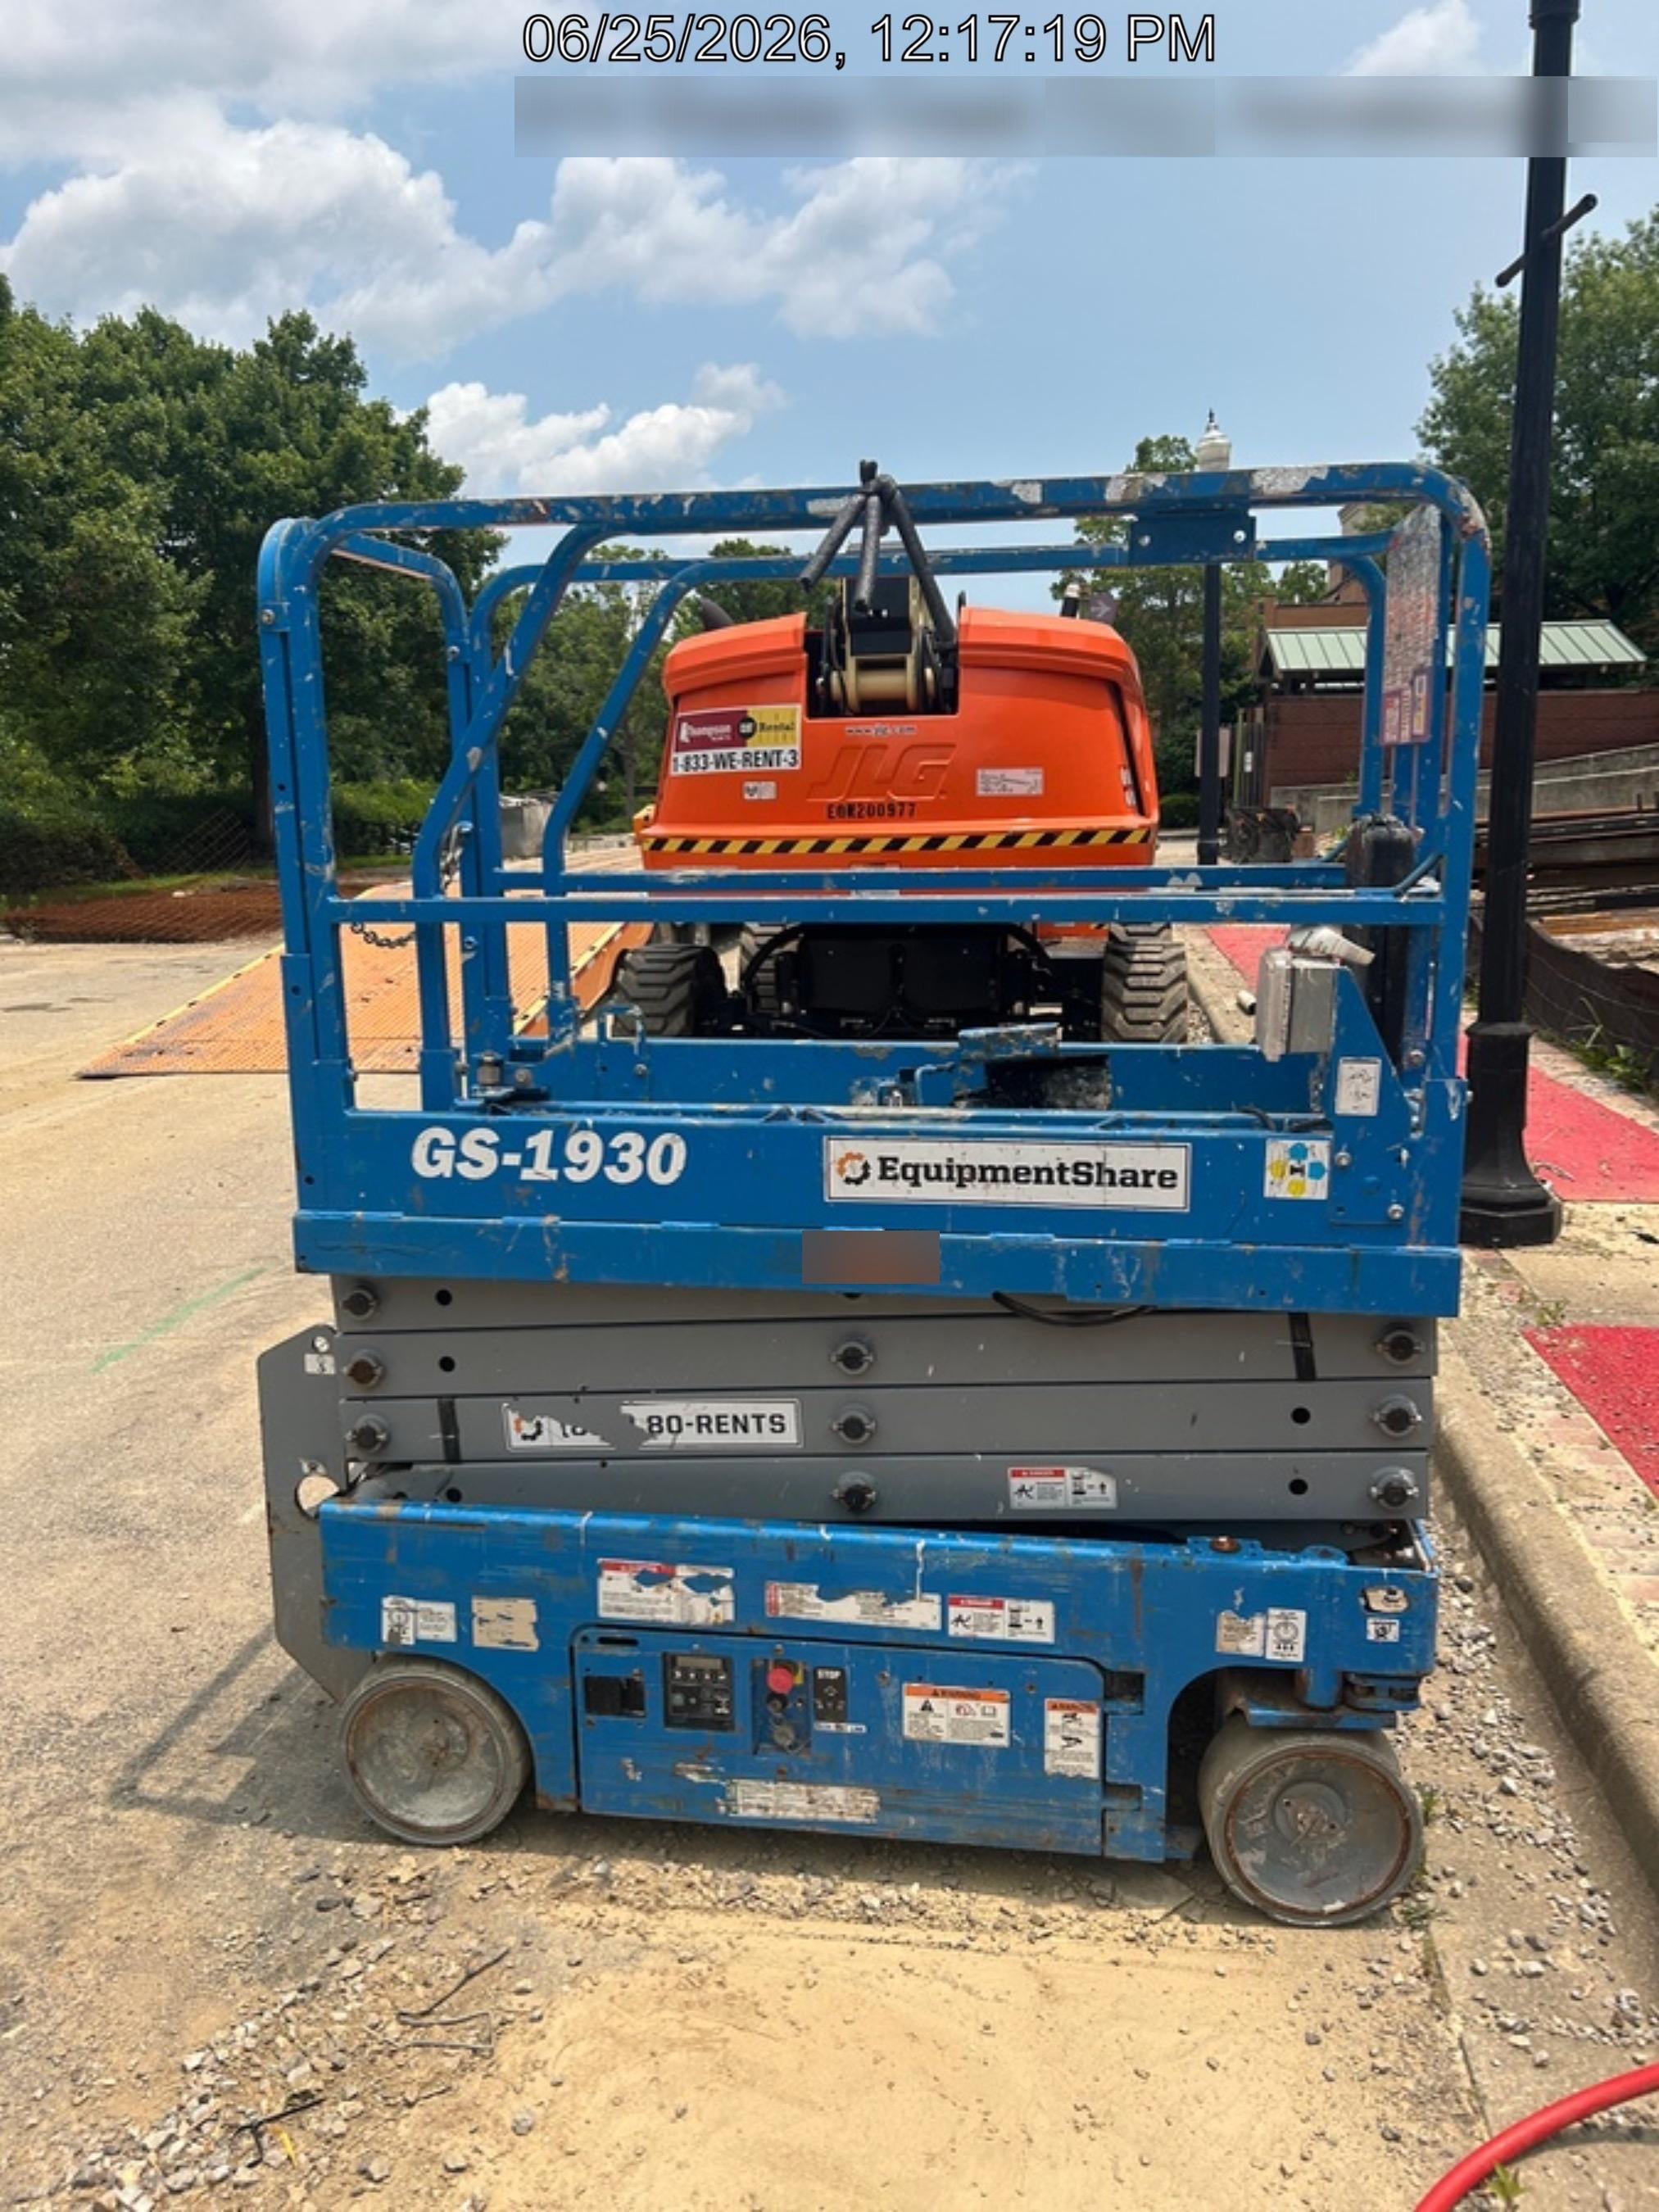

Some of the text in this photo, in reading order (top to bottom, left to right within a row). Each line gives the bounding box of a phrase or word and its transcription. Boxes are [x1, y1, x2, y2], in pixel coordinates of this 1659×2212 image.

[673, 749, 799, 773] 1-833-WE-RENT-3
[806, 742, 957, 801] JLG
[411, 1126, 687, 1185] GS-1930
[877, 1156, 1179, 1189] EquipmentShare
